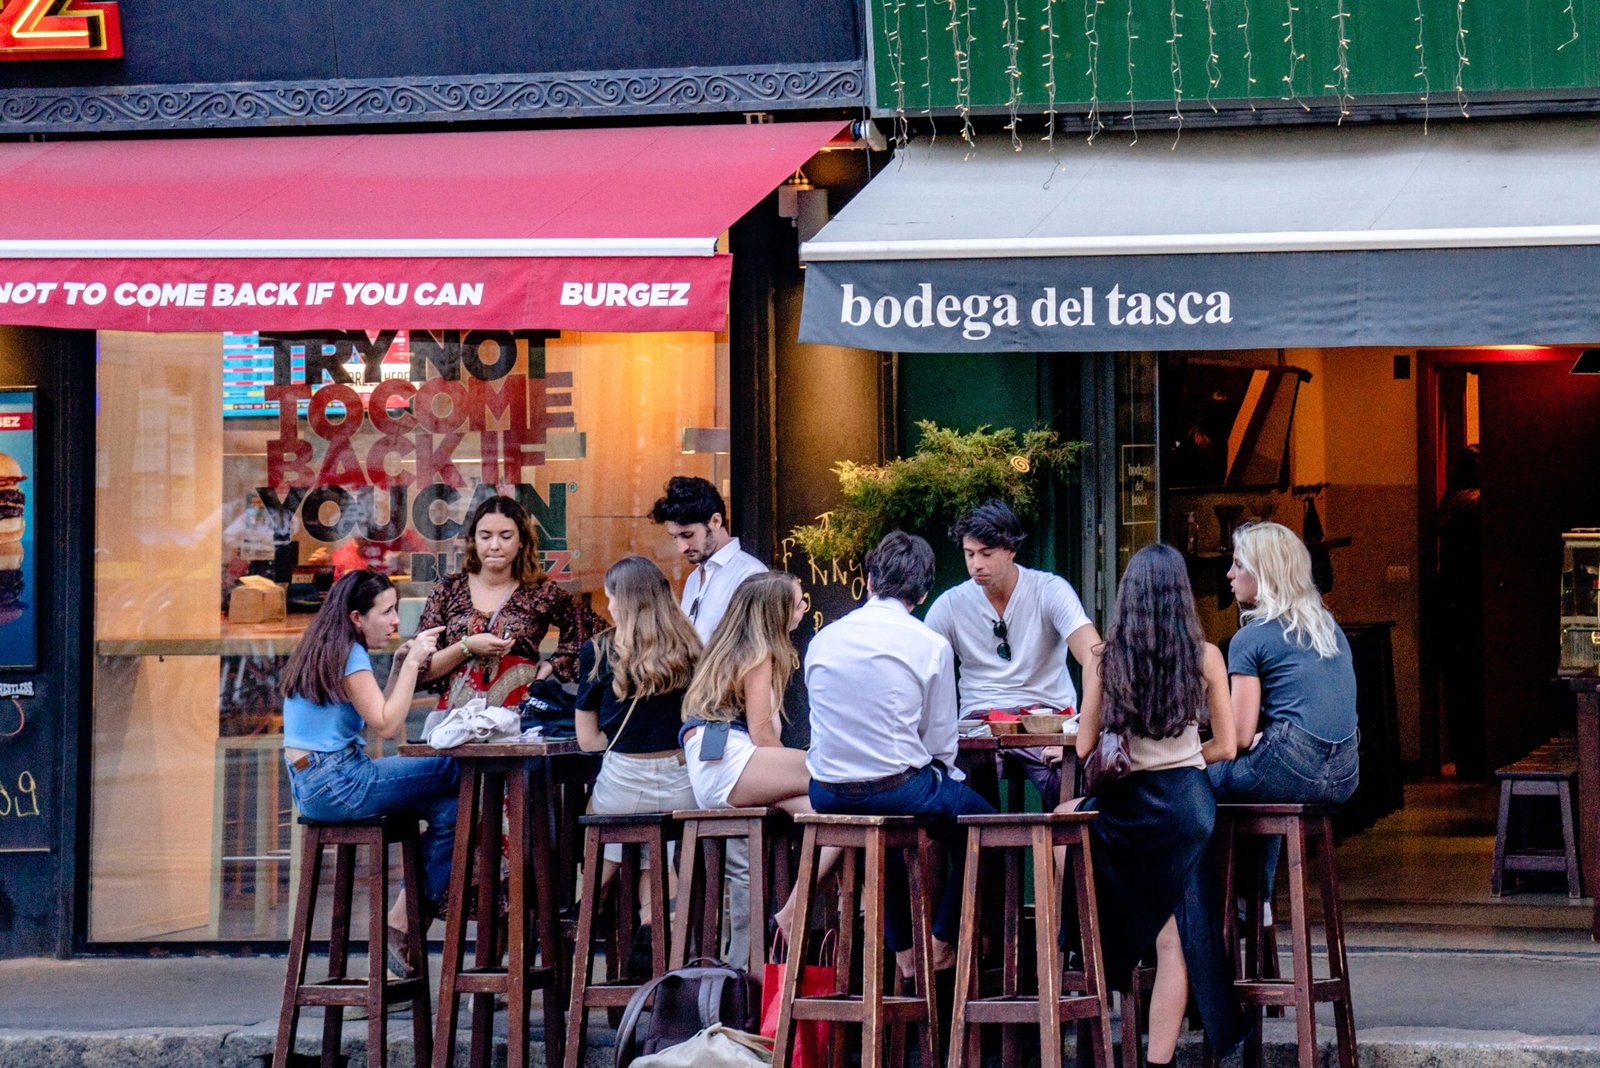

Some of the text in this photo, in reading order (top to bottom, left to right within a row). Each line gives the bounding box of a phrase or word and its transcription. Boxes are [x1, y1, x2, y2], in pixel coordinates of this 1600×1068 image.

[63, 281, 107, 306] TO
[113, 282, 207, 307] COME
[211, 282, 301, 307] BACK
[305, 281, 335, 306] IF
[341, 281, 409, 306] YOU
[413, 282, 484, 306] CAN
[559, 281, 691, 307] BURGEZ
[840, 282, 1234, 341] bodega del tasca
[259, 329, 399, 386] TRY
[408, 329, 560, 382] NOT
[264, 371, 575, 441] TO COME
[266, 430, 546, 490] BACK IF
[256, 483, 409, 543] YOU
